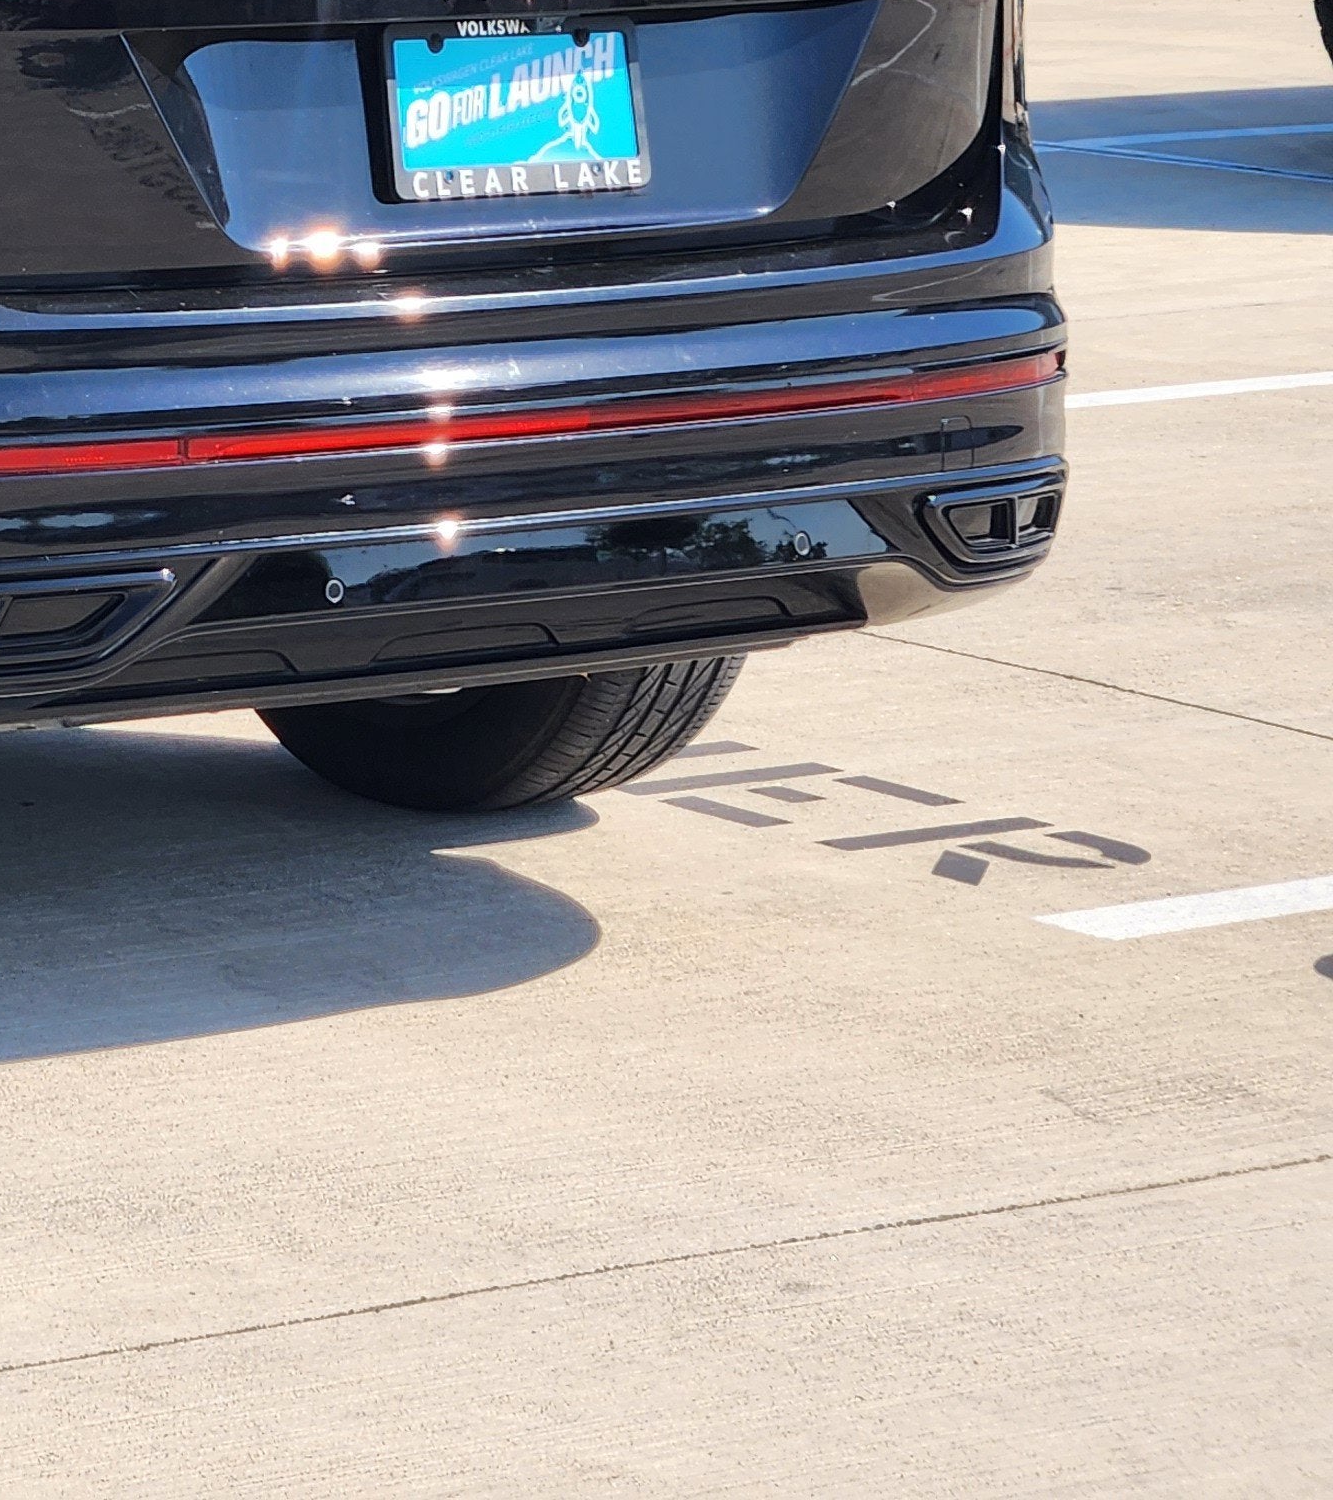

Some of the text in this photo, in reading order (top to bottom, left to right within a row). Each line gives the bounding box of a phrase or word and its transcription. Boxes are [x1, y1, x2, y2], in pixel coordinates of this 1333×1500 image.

[406, 91, 452, 149] GO
[452, 83, 487, 128] FOR
[488, 31, 616, 119] LAUNCH
[412, 159, 643, 199] CLEAR LAKE
